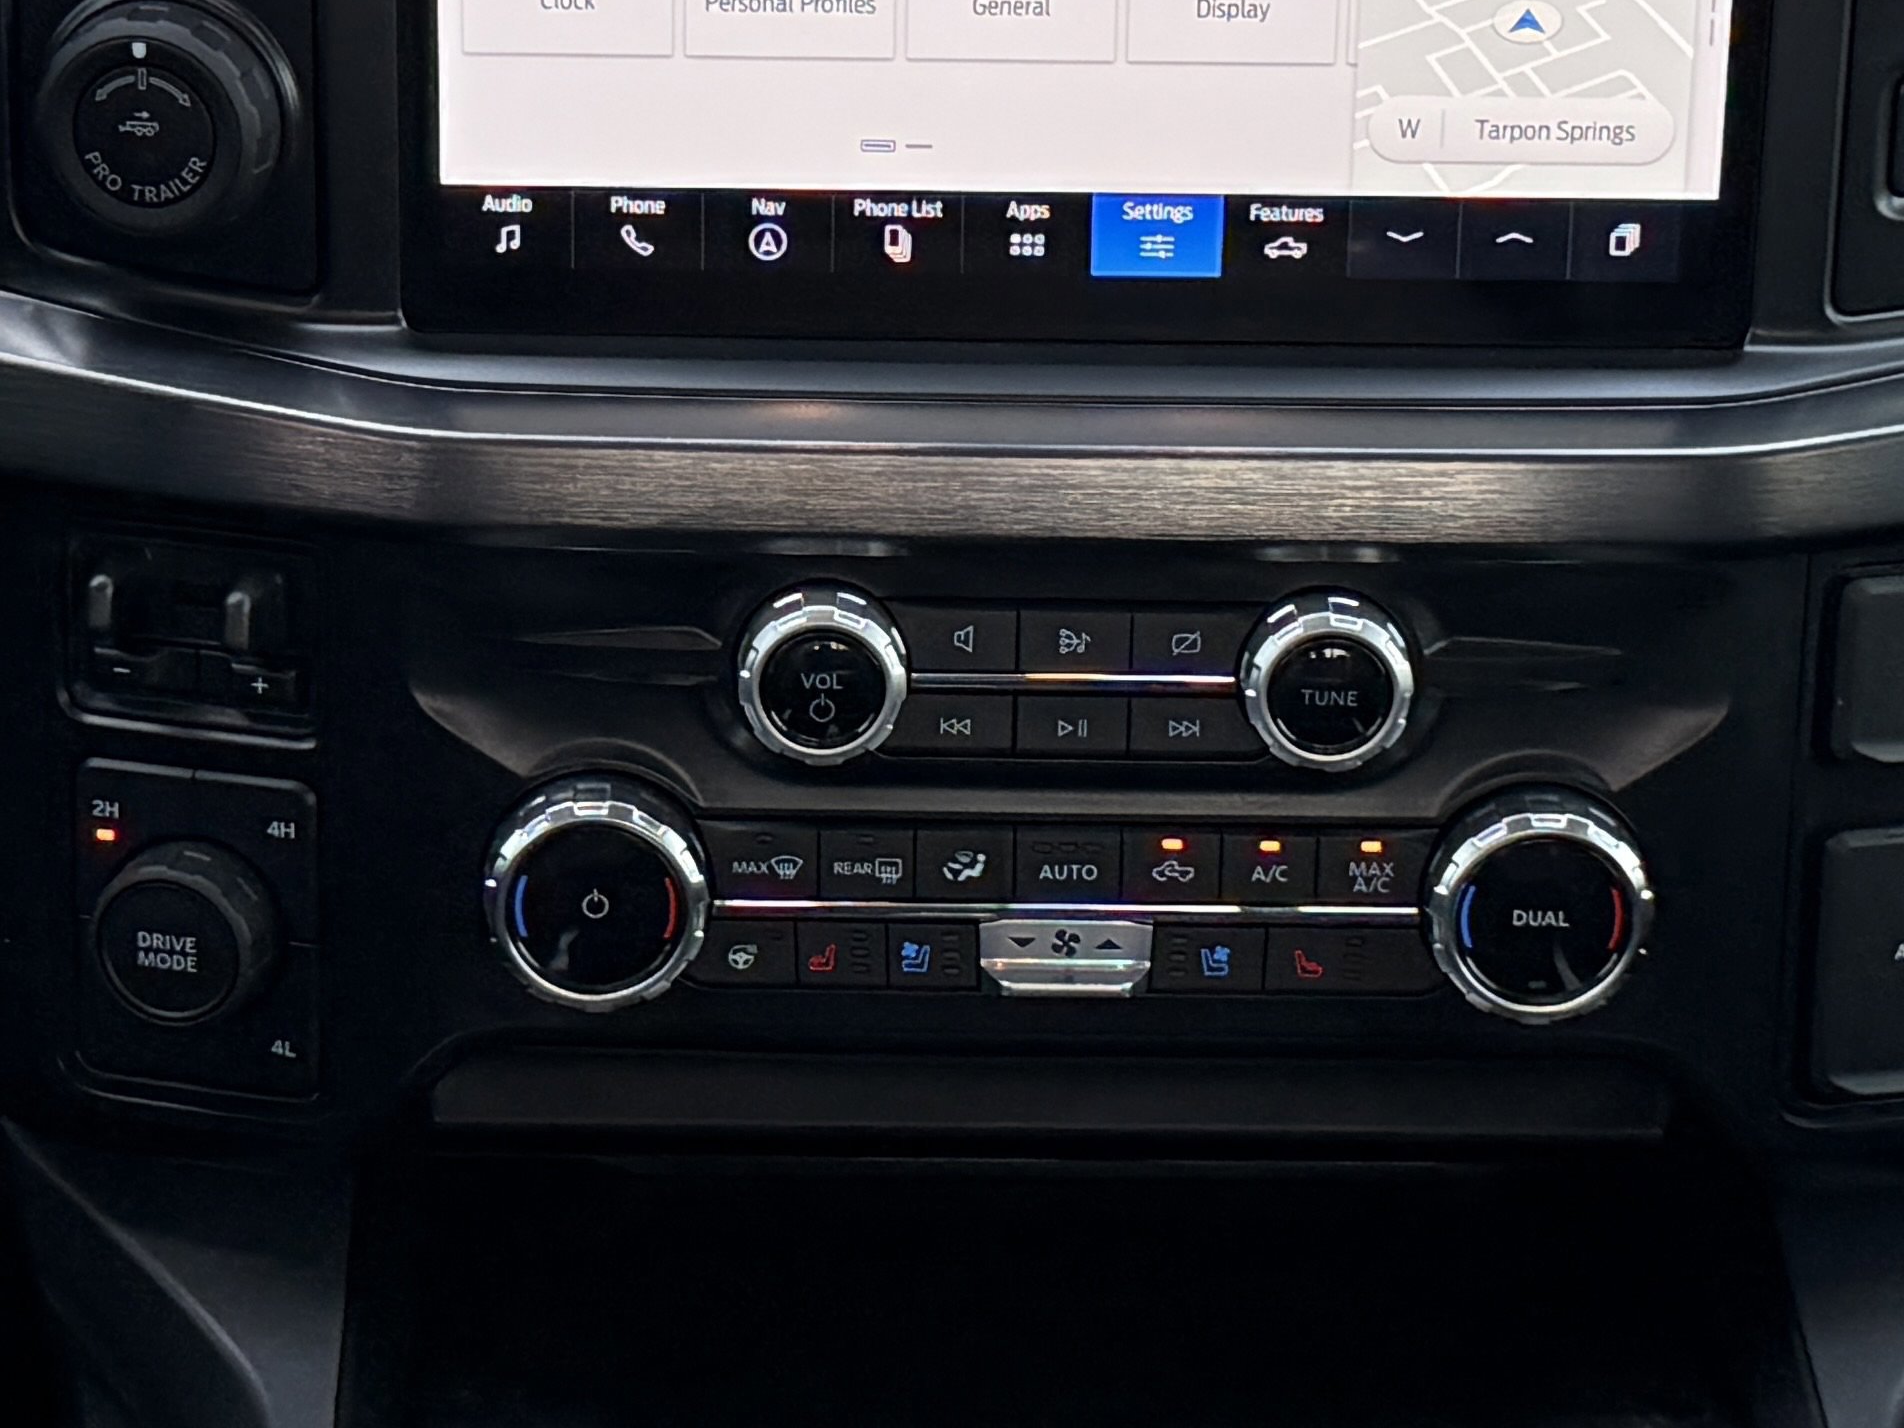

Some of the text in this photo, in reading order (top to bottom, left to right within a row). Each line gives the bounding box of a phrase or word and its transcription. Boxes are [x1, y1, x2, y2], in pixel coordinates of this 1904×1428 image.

[1397, 118, 1422, 139] W
[1475, 118, 1636, 146] Tarpon Springs
[83, 149, 209, 206] PRO TRAILER
[482, 194, 534, 214] Audio
[610, 195, 666, 215] Phone
[751, 196, 787, 216] Nav
[853, 198, 944, 219] Phone List
[1006, 200, 1051, 223] Apps
[1121, 201, 1194, 224] Settings
[1249, 203, 1325, 224] Features
[800, 674, 844, 692] VOL
[1300, 688, 1359, 708] TUNE
[92, 799, 120, 819] 2H
[266, 821, 296, 840] 4H
[732, 860, 769, 876] MAX
[833, 860, 873, 876] REAR
[1039, 864, 1099, 882] AUTO
[1251, 864, 1289, 884] A/C
[1348, 861, 1395, 878] MAX
[1352, 876, 1391, 894] A/C
[1512, 908, 1570, 929] DUAL
[136, 931, 197, 954] DRIVE
[136, 951, 198, 973] MODE
[270, 1040, 297, 1059] 4L
